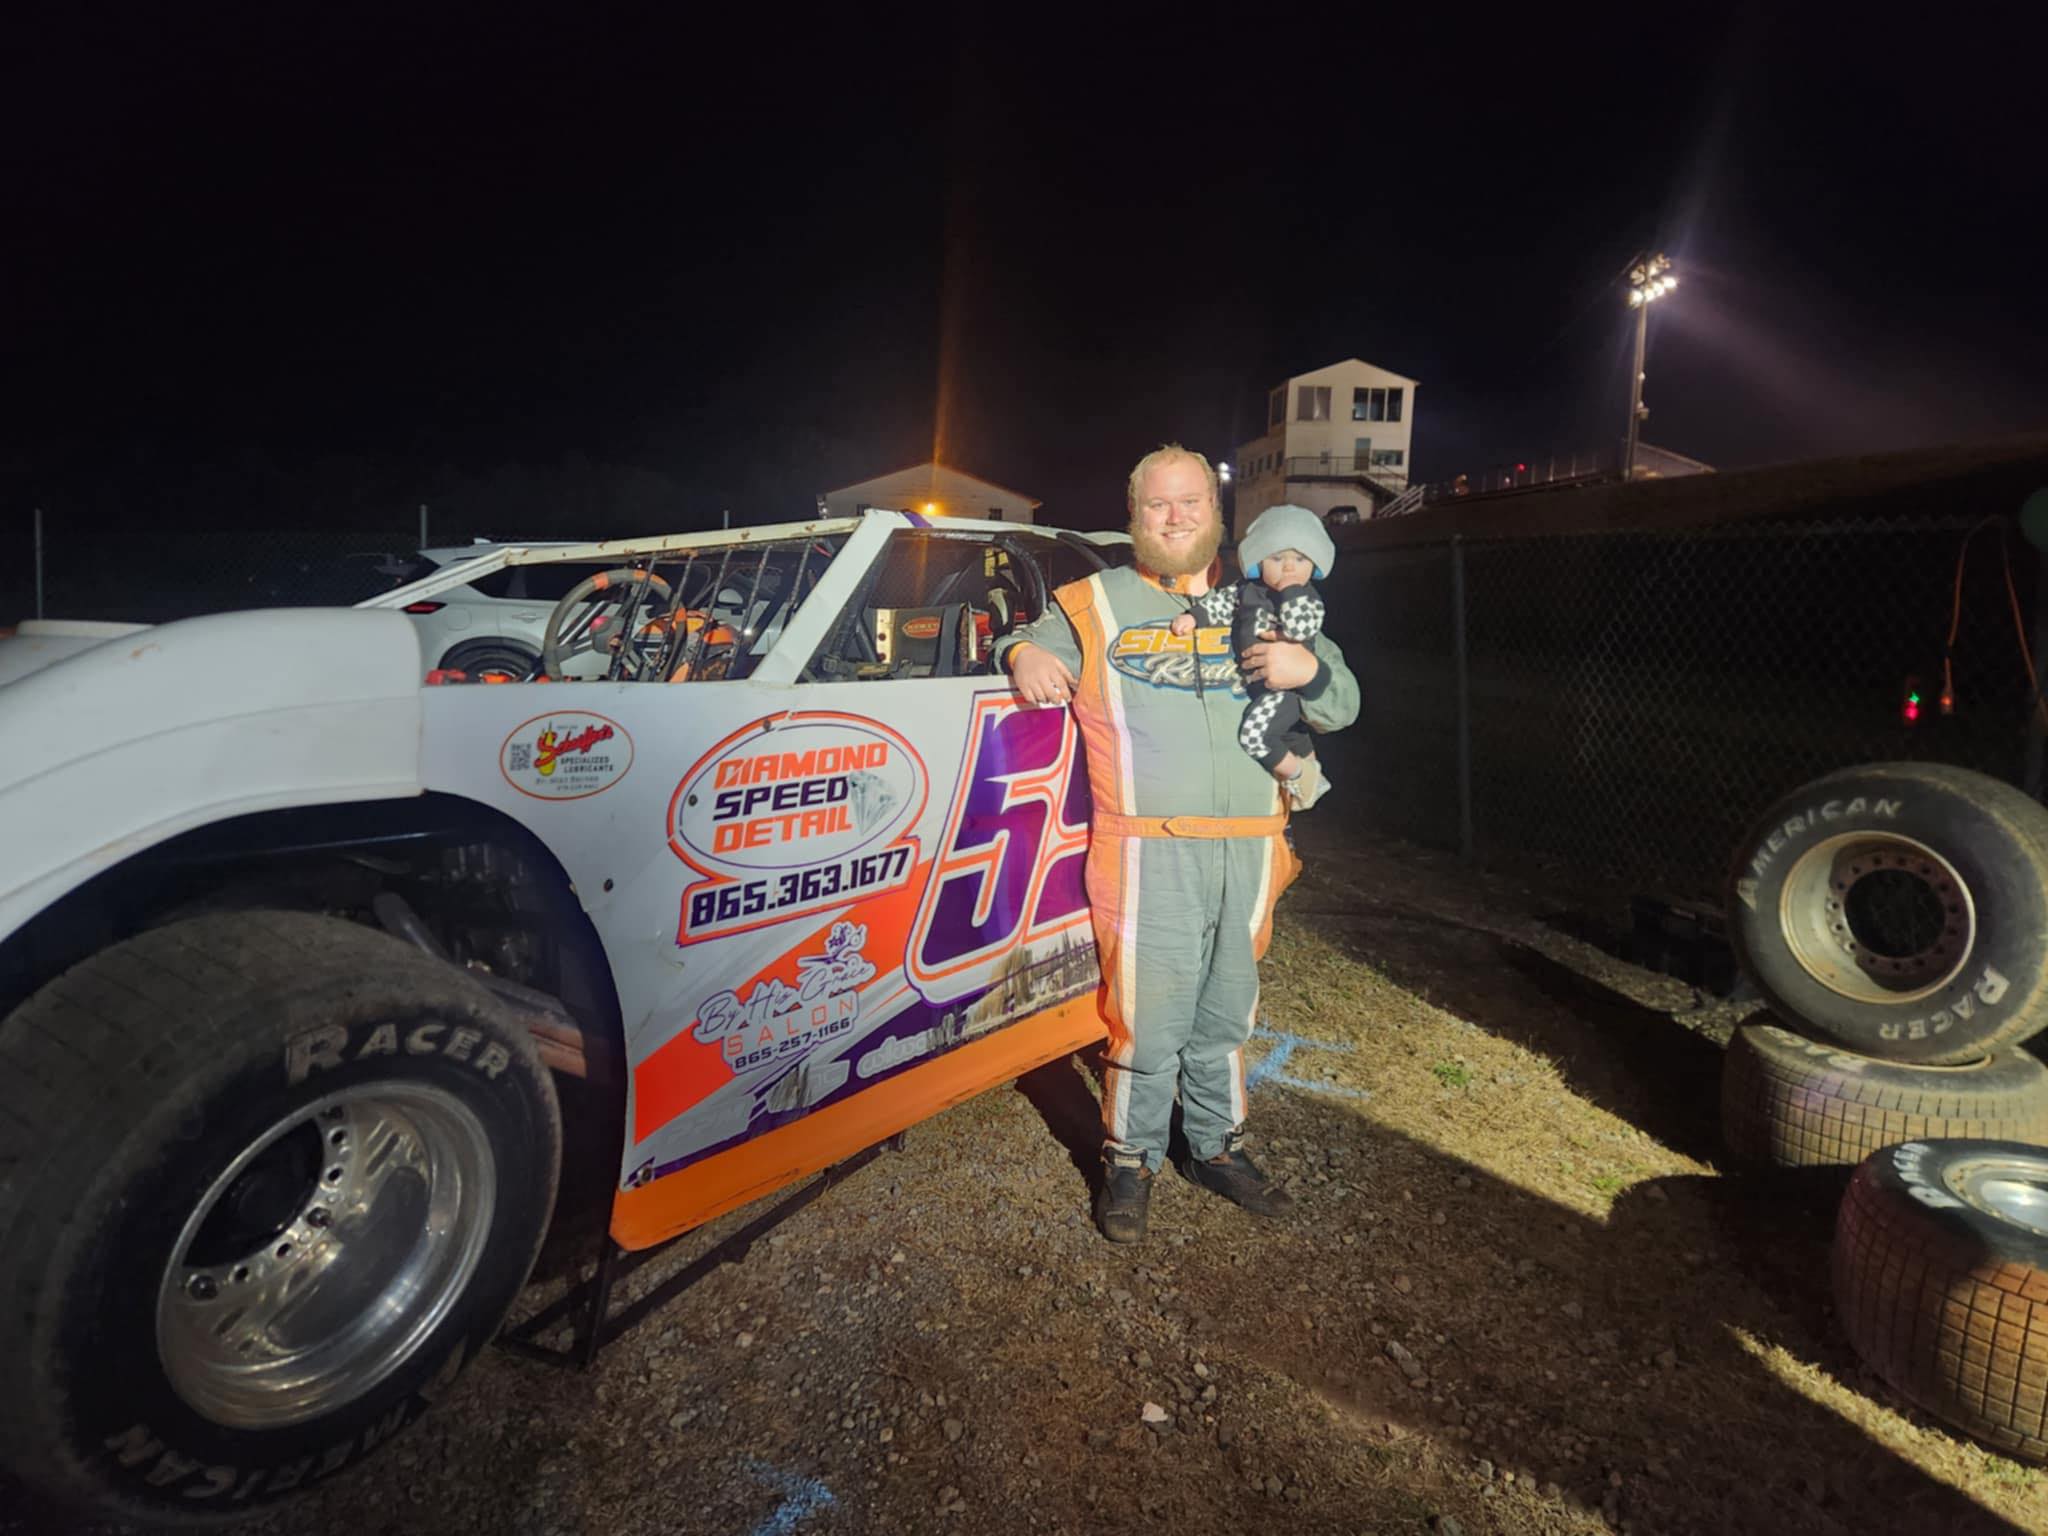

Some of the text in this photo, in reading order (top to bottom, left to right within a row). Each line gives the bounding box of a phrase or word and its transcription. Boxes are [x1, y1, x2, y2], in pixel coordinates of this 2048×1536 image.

[713, 742, 888, 789] DIAMOND
[713, 775, 850, 822] SPEED
[713, 804, 853, 854] DETAIL
[1737, 798, 1901, 912] AMERICAN
[690, 846, 910, 929] 865.363.1677
[703, 996, 739, 1036] By
[727, 997, 854, 1057] SALON
[1879, 966, 2011, 1043] RACER
[286, 1021, 511, 1086] RACER
[734, 1017, 851, 1070] 865-257-1166
